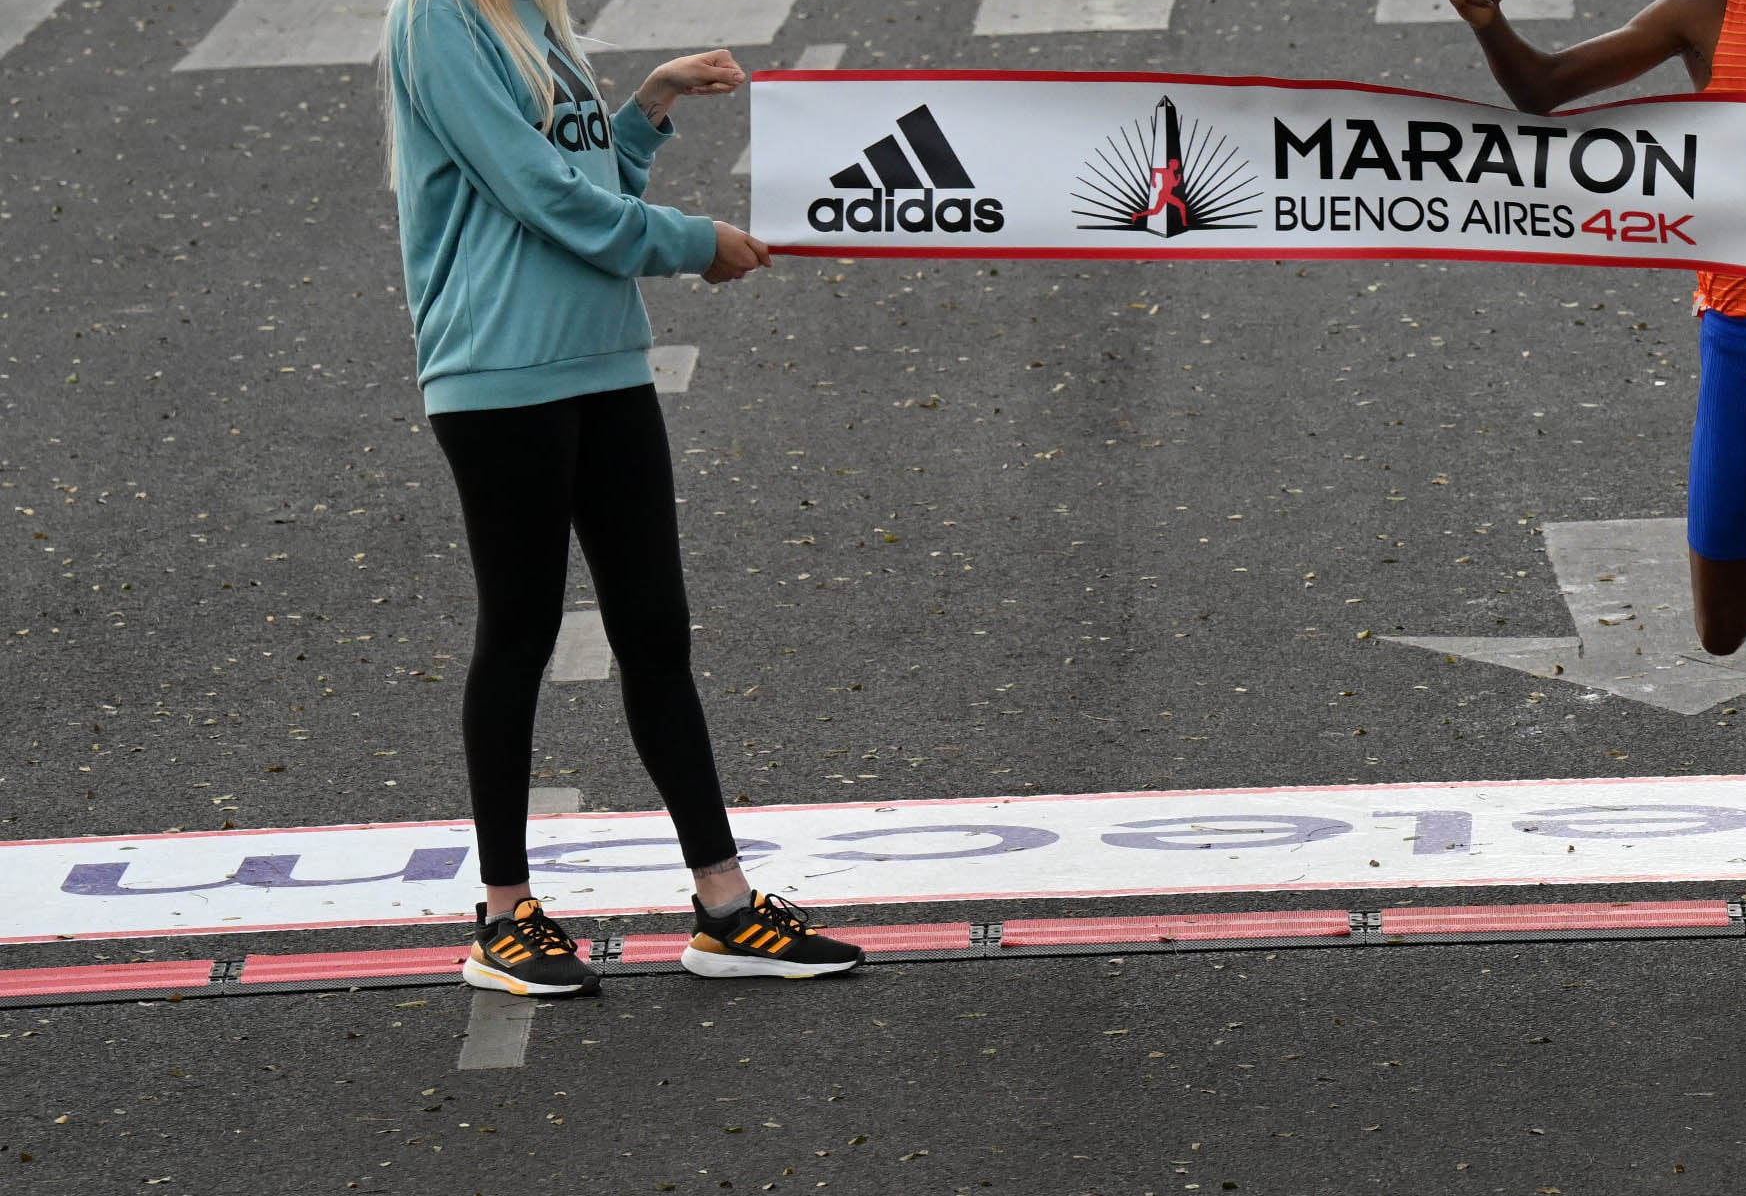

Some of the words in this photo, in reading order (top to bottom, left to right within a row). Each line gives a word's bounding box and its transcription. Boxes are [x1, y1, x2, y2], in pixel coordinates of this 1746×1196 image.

[1274, 116, 1697, 200] MARATON
[807, 188, 1004, 233] adidas
[1275, 195, 1450, 232] BUENOS
[1461, 199, 1575, 239] AIRES
[1580, 208, 1697, 246] 42K
